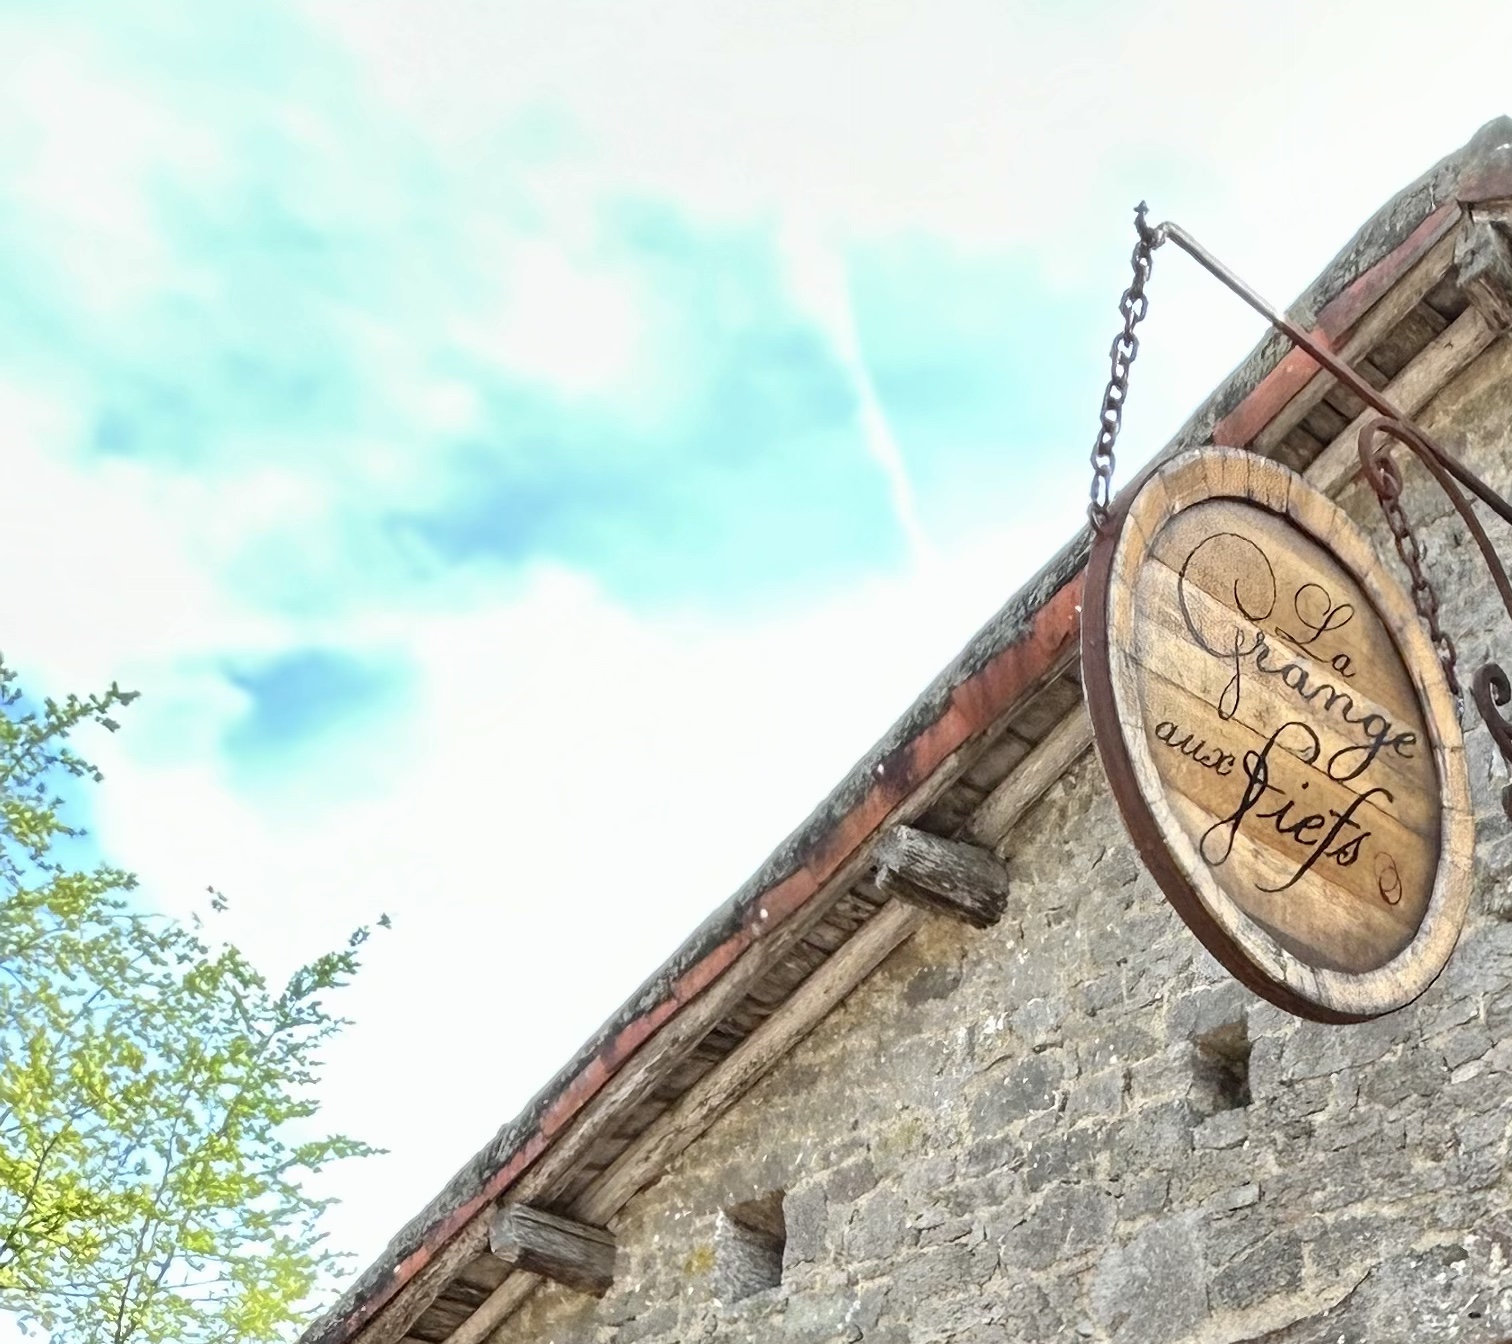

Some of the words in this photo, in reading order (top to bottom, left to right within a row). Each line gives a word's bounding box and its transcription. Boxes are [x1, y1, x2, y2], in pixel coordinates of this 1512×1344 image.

[1178, 532, 1420, 783] Grange
[1275, 583, 1357, 678] La
[1155, 719, 1235, 776] aux
